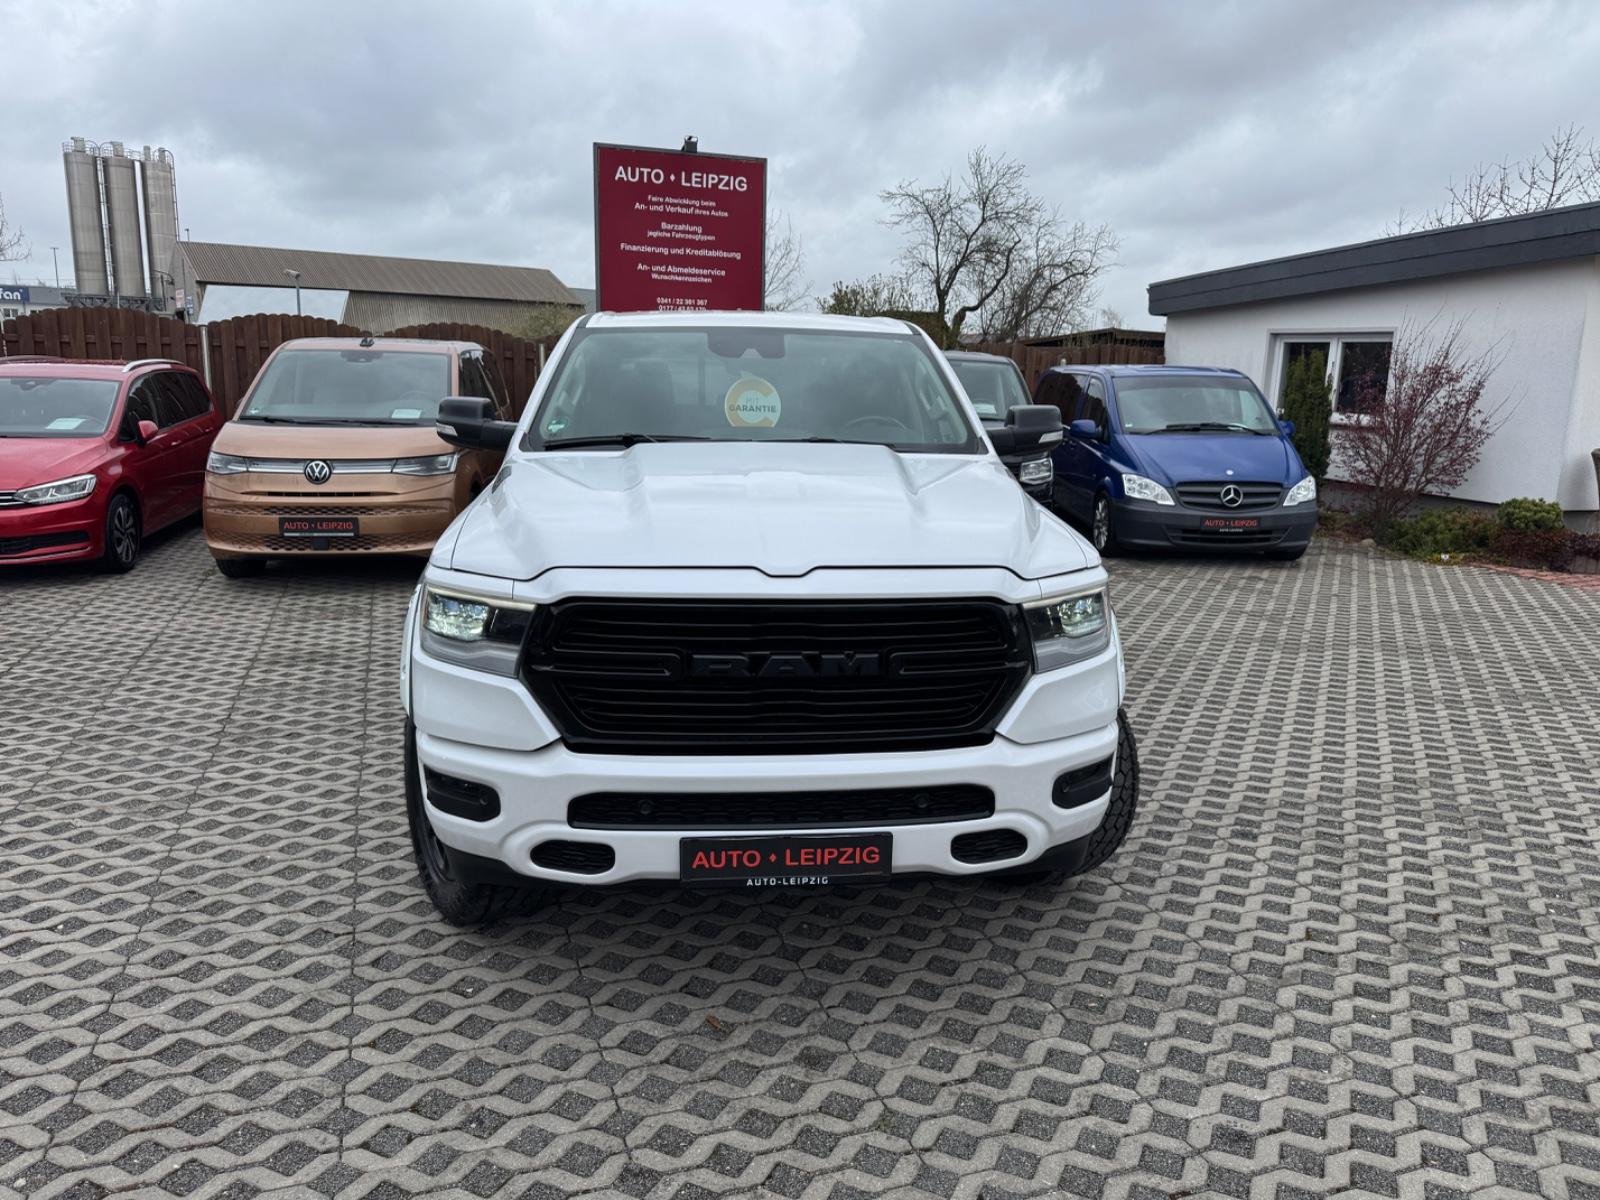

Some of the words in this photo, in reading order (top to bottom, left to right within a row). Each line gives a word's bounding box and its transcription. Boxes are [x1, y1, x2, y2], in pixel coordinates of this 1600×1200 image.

[614, 165, 665, 184] AUTO
[681, 171, 748, 192] LEIPZIG
[647, 194, 664, 203] Faire
[664, 196, 700, 207] Abwicklung
[634, 202, 648, 210] An-
[649, 204, 664, 212] und
[665, 205, 695, 215] Verkauf
[710, 209, 729, 217] Autos
[661, 221, 703, 233] Barzahlung
[620, 242, 669, 255] Finanzierung
[685, 247, 742, 260] Kreditablösung
[637, 262, 651, 271] An-
[651, 264, 666, 272] und
[667, 265, 726, 277] Abmeldeservice
[728, 403, 777, 413] GARANTIE
[283, 521, 309, 530] AUTO
[317, 521, 353, 530] LEIPZIG
[690, 652, 881, 678] RAM
[691, 850, 761, 869] AUTO
[785, 846, 880, 866] LEIPZIG
[746, 876, 829, 886] AUTO-LEIPZIG
